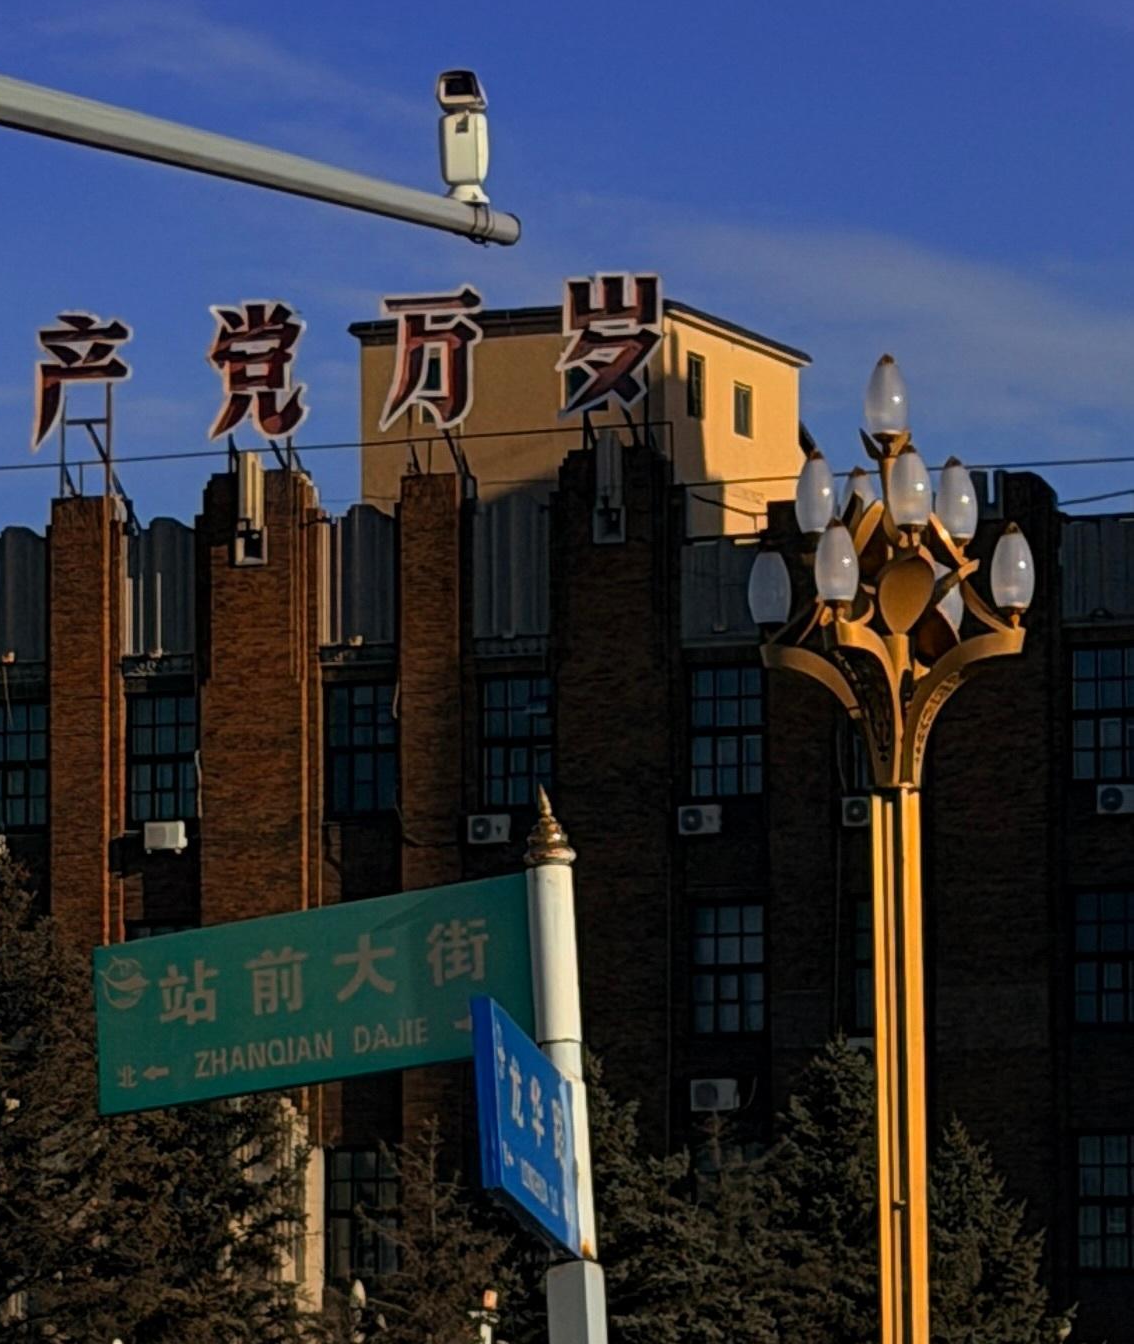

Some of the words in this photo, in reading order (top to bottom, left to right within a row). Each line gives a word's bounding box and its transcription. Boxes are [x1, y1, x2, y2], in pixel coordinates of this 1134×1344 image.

[158, 918, 490, 1026] 站前大街
[117, 1064, 137, 1089] 北
[194, 1032, 334, 1080] ZHANQIAN
[353, 1017, 429, 1050] DAJIE
